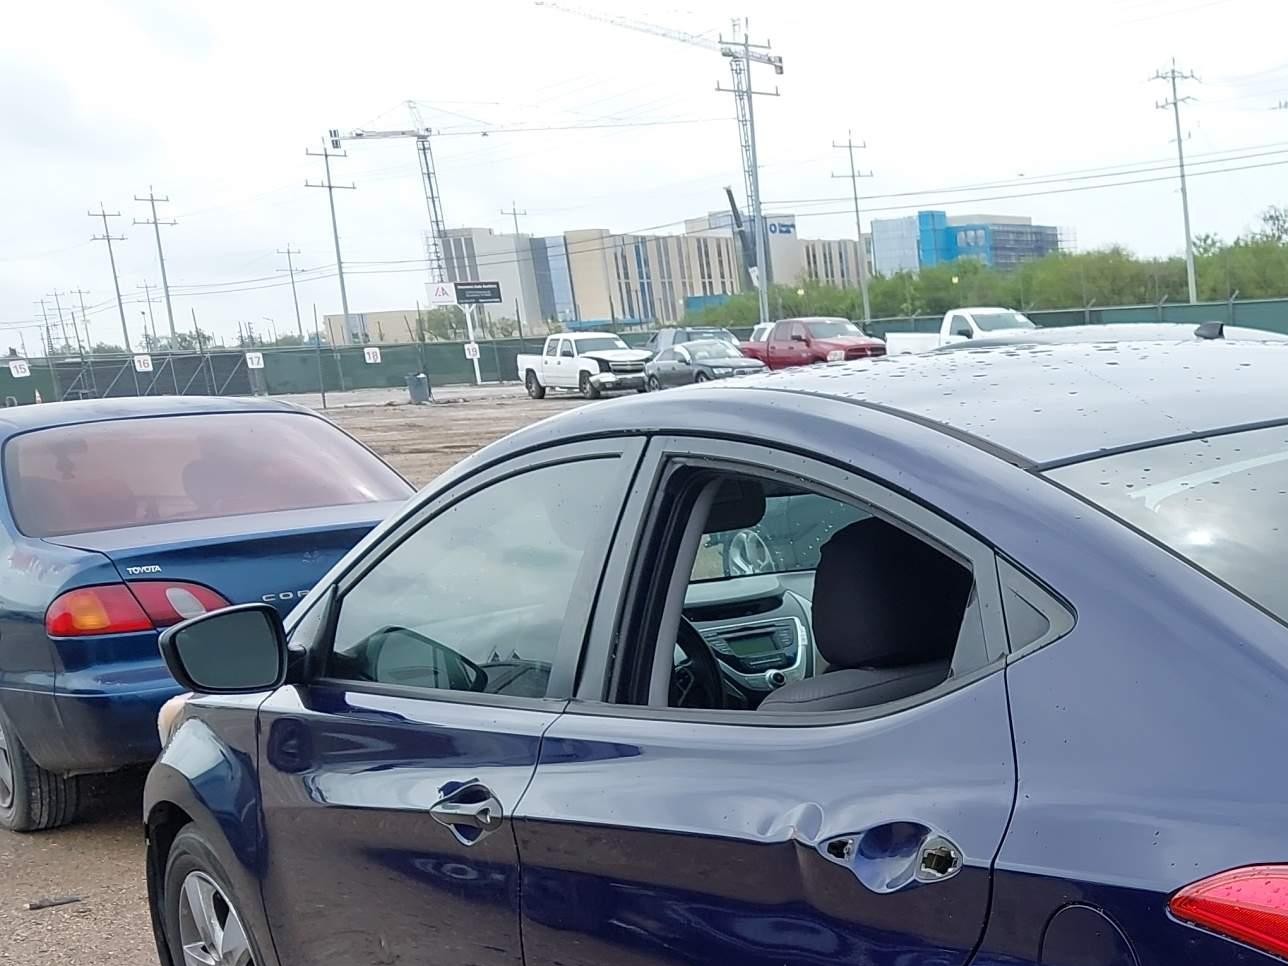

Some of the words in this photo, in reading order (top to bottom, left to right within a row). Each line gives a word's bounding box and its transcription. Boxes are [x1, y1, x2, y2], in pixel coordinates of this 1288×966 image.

[248, 356, 261, 366] 17
[366, 351, 378, 361] 18
[136, 359, 150, 368] 16
[12, 364, 27, 375] 15
[126, 565, 162, 574] TOYOTA
